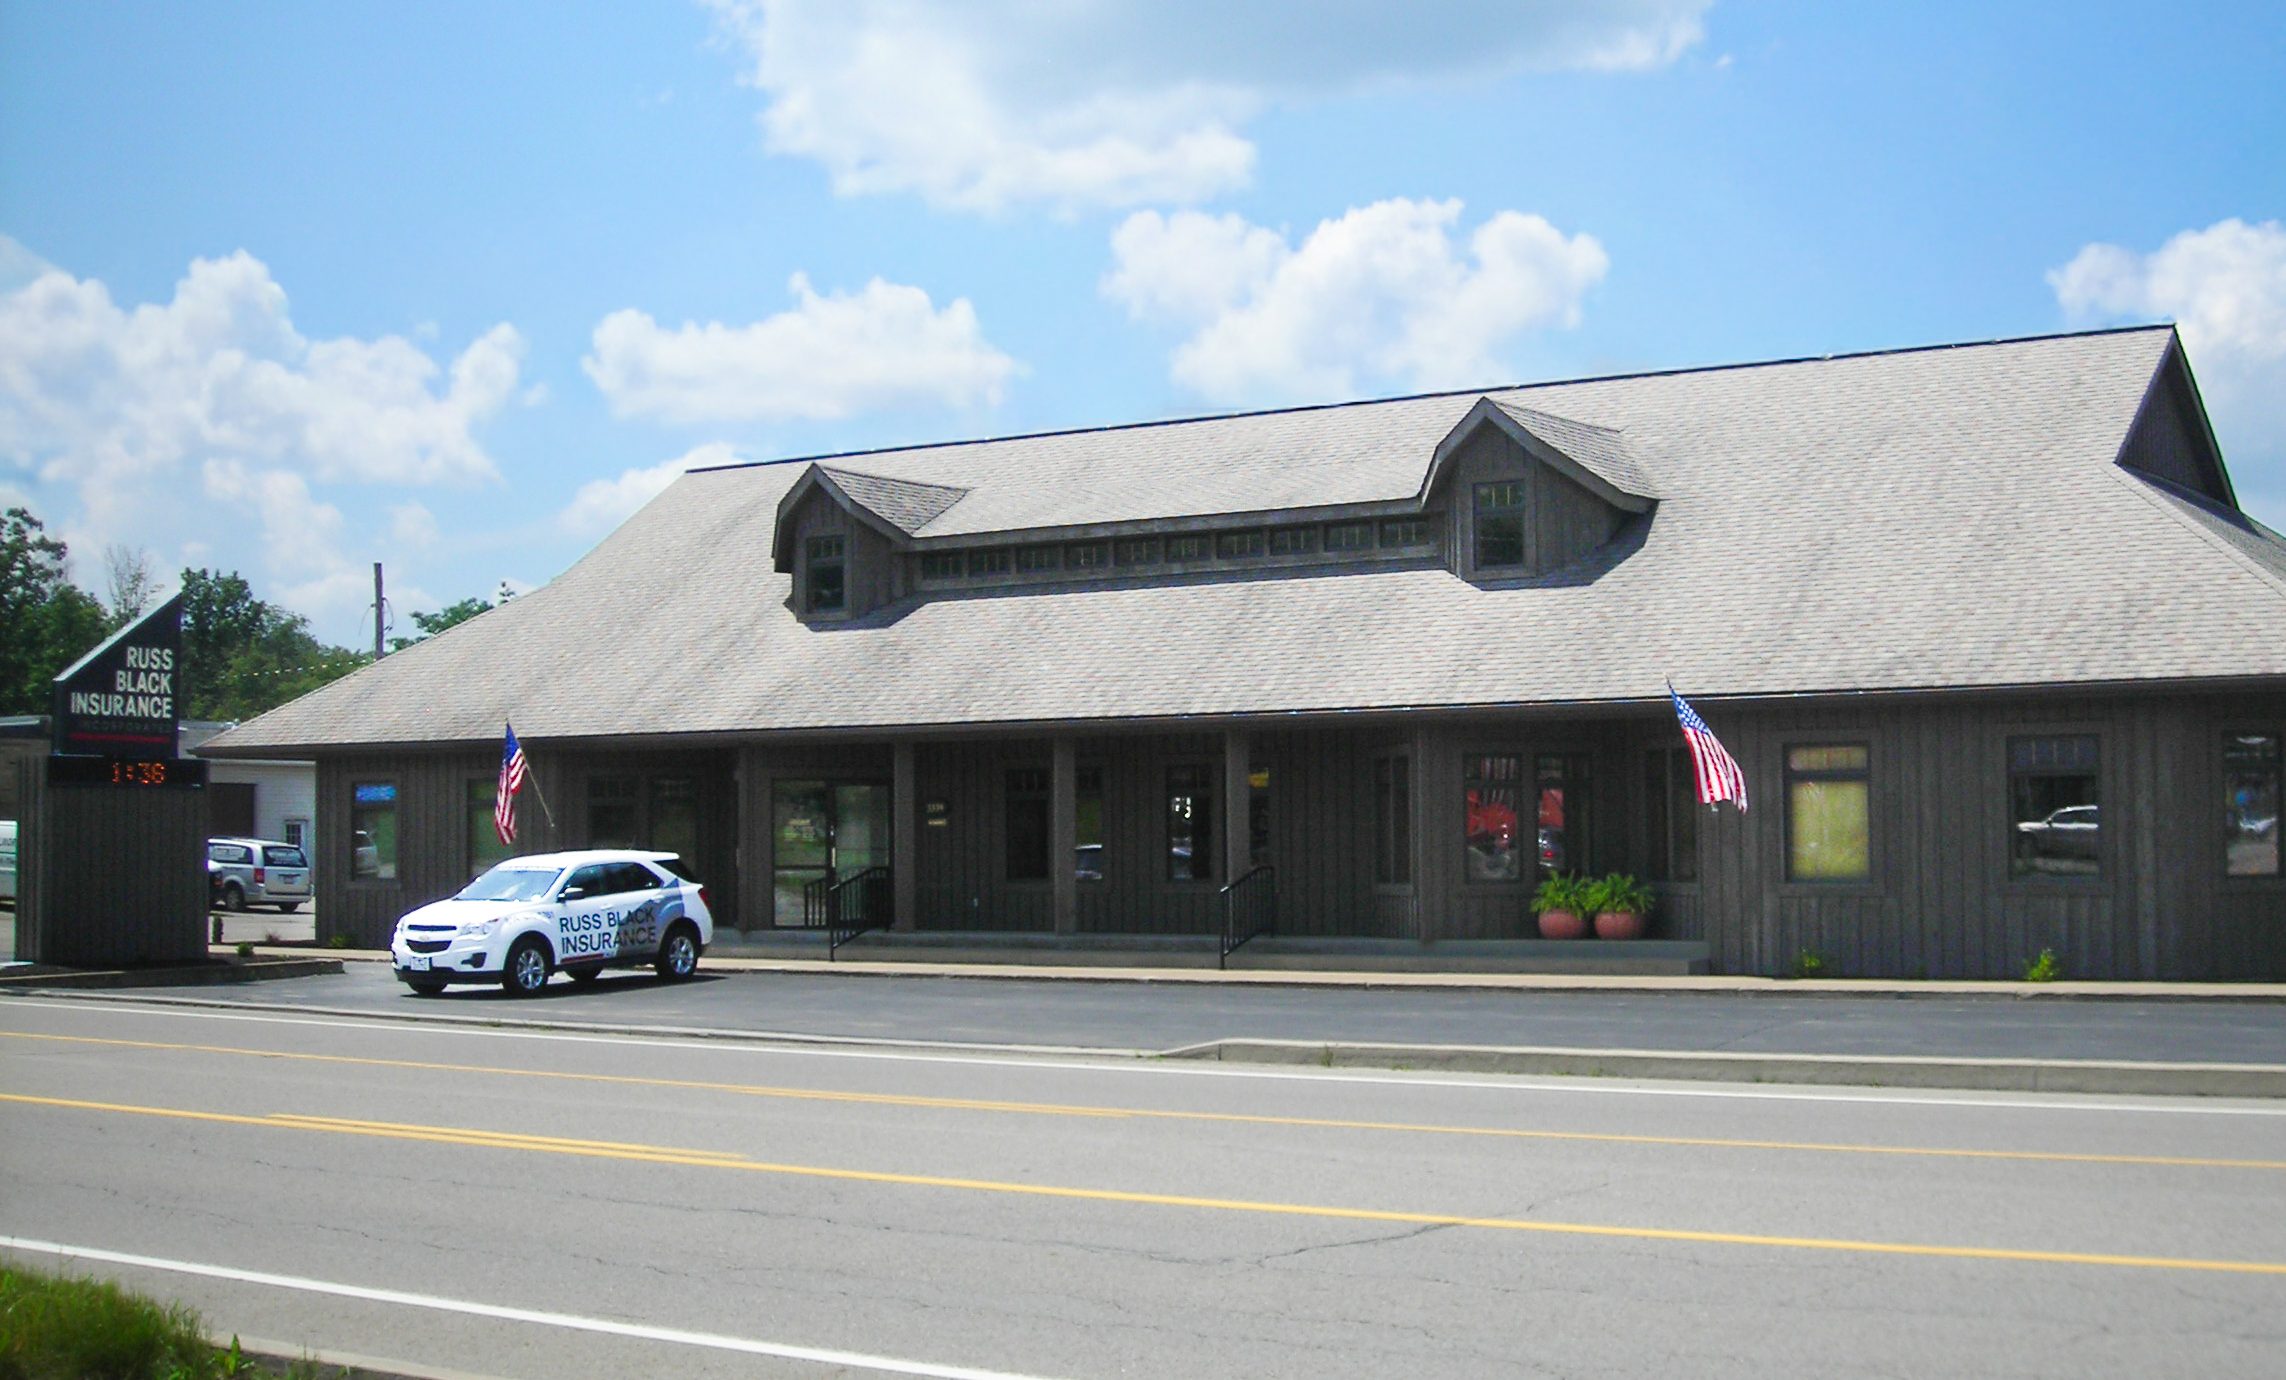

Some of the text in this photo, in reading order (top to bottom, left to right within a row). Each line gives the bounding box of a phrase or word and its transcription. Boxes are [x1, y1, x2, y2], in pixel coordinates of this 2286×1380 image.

[127, 646, 173, 670] RUSS
[116, 670, 172, 694] BLACK
[71, 692, 172, 718] INSURANCE
[560, 914, 602, 932] RUSS
[607, 907, 654, 927] BLACK
[562, 926, 656, 954] INSURANCE
